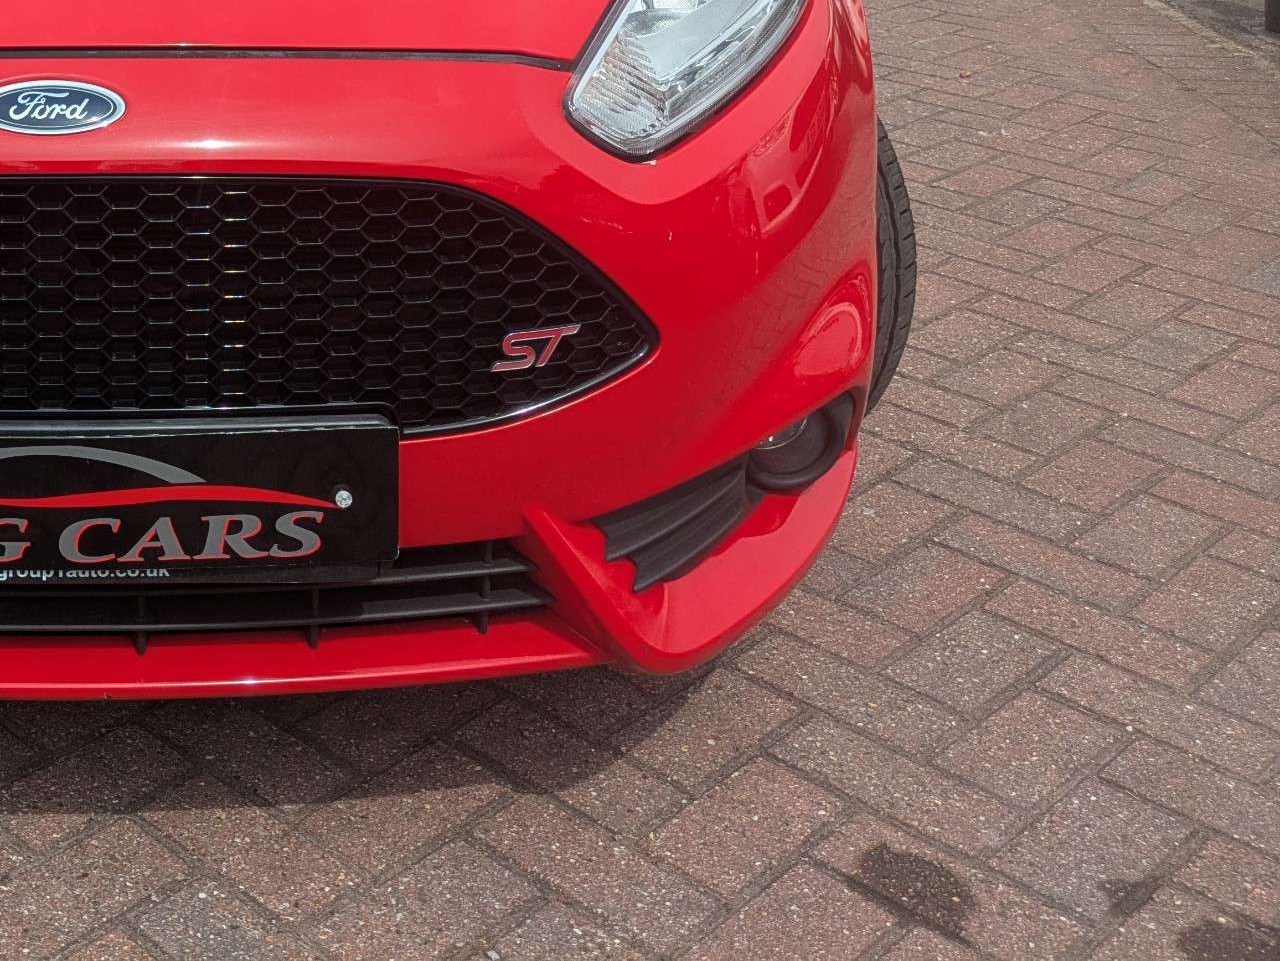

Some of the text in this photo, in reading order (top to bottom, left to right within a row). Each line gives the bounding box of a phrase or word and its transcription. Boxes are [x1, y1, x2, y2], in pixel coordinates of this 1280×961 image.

[9, 91, 90, 120] Ford
[490, 324, 581, 372] ST
[58, 510, 325, 565] CARS
